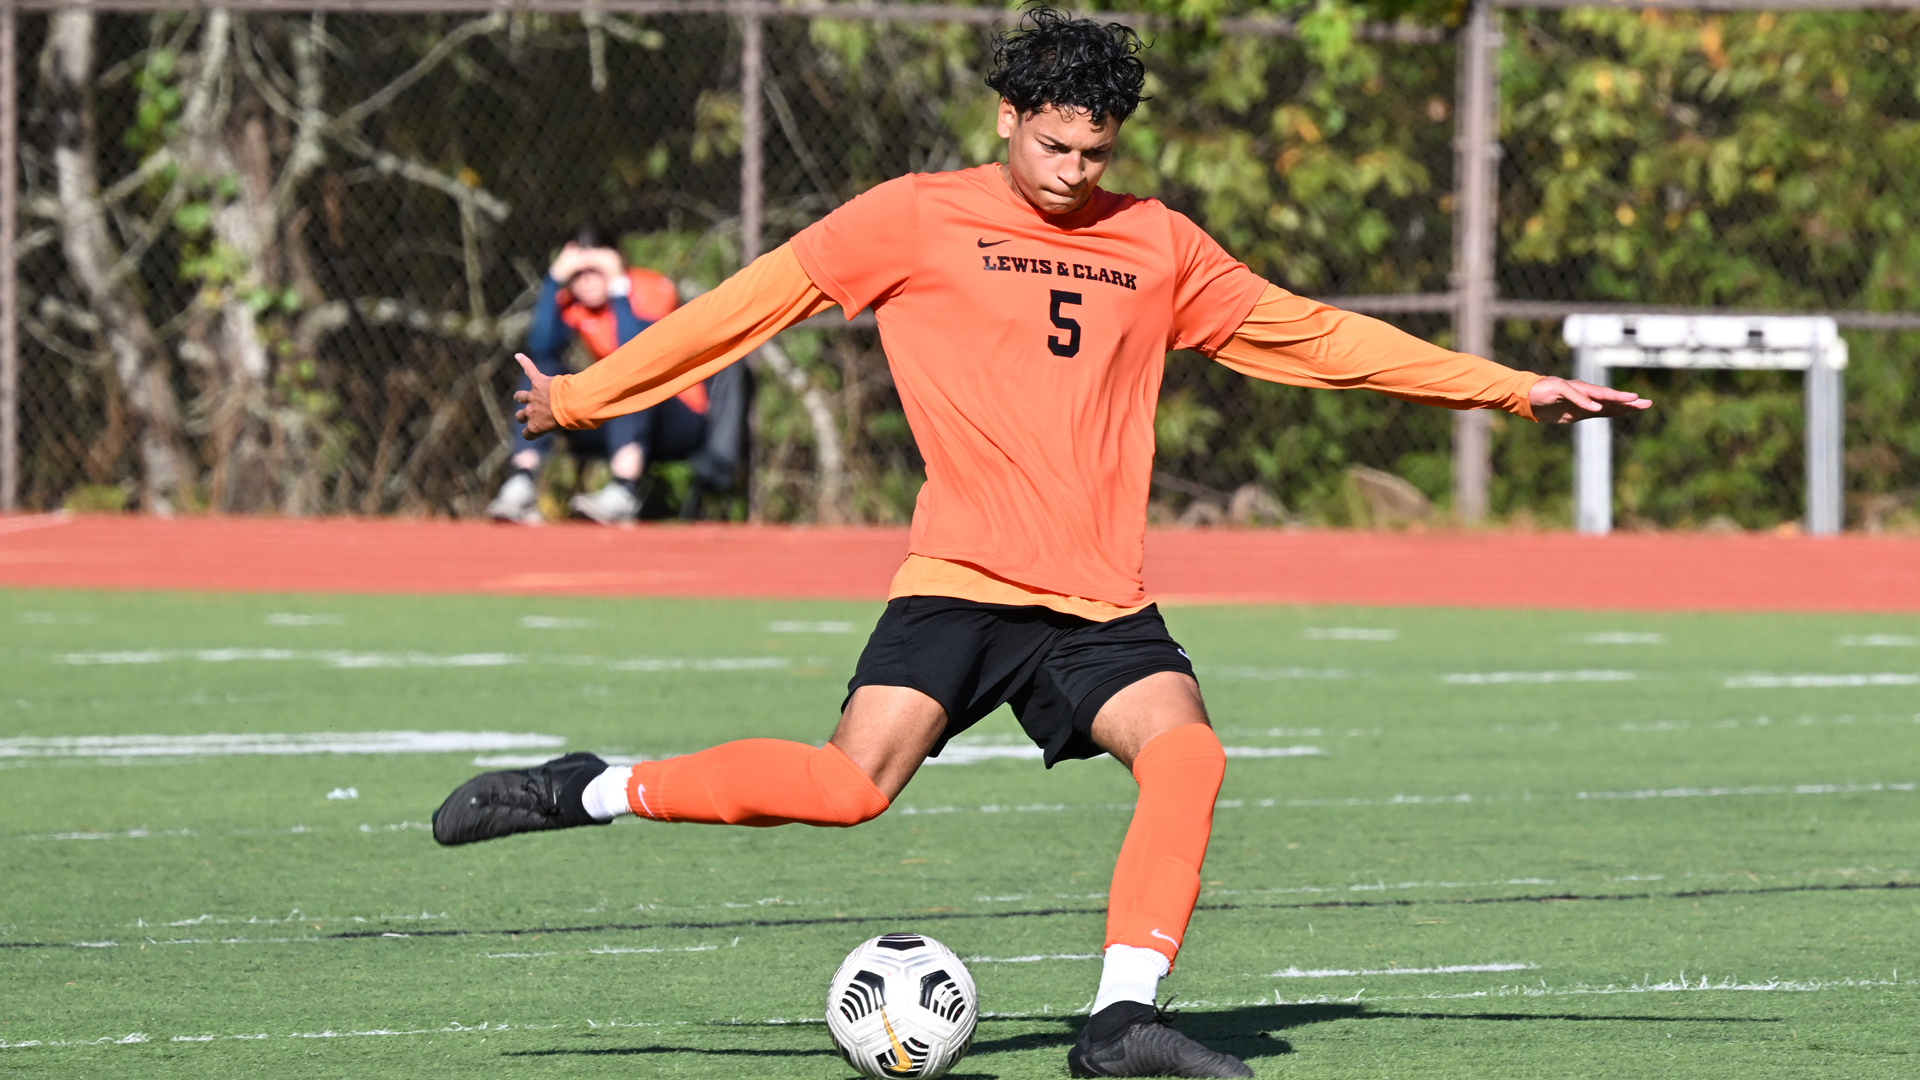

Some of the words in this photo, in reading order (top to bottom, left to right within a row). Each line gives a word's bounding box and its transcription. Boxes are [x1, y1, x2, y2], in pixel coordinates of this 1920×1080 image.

[982, 255, 1052, 274] LEWIS
[1056, 261, 1069, 276] &
[1073, 263, 1137, 290] CLARK
[1047, 288, 1082, 358] 5
